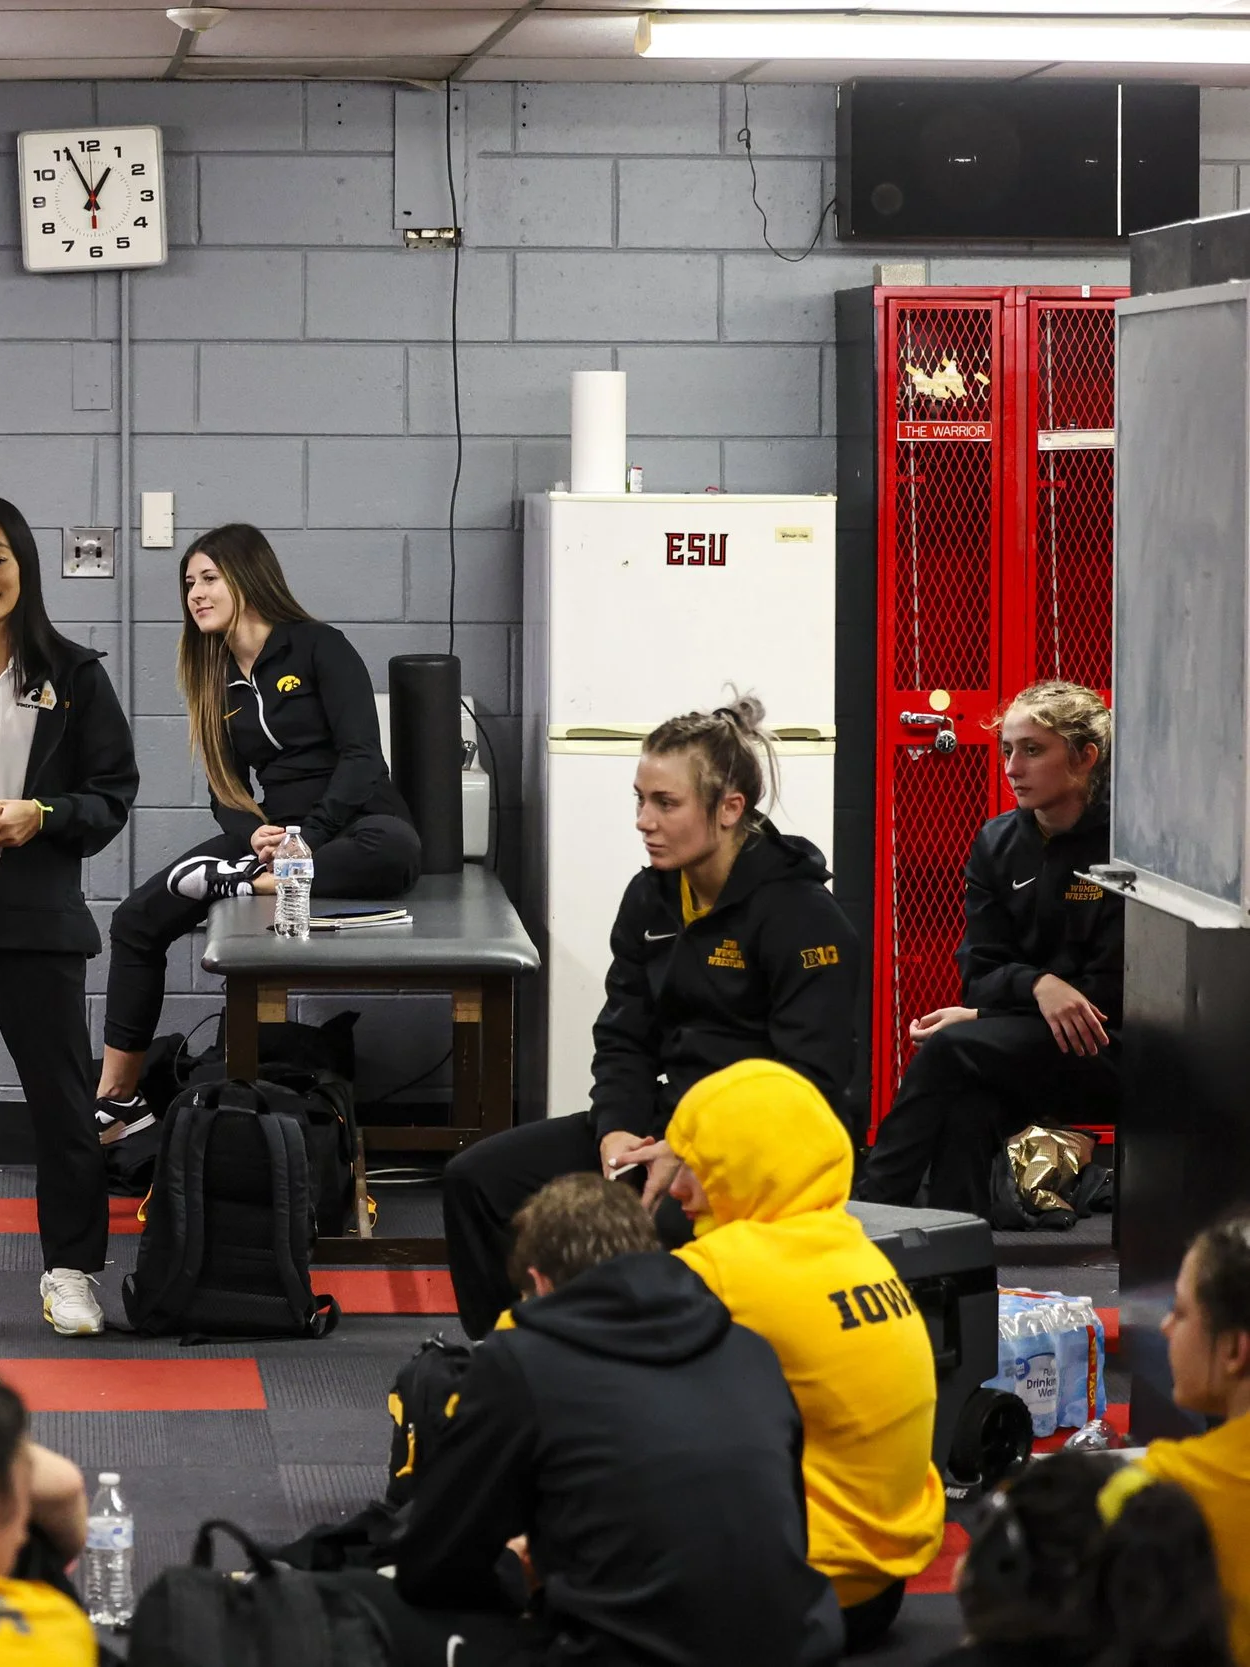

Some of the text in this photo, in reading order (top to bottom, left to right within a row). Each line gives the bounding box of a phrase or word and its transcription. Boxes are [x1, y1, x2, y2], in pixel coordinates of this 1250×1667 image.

[78, 140, 100, 152] 12
[114, 146, 122, 158] 1
[53, 148, 72, 162] 11
[33, 169, 56, 181] 10
[131, 163, 145, 176] 2
[32, 196, 46, 208] 9
[140, 190, 154, 202] 3
[133, 216, 148, 228] 4
[42, 223, 55, 234] 8
[61, 240, 75, 252] 7
[116, 236, 130, 249] 5
[89, 246, 103, 258] 6
[905, 425, 986, 438] THE WARRIOR
[665, 532, 729, 566] ESU
[828, 1278, 916, 1331] IOW
